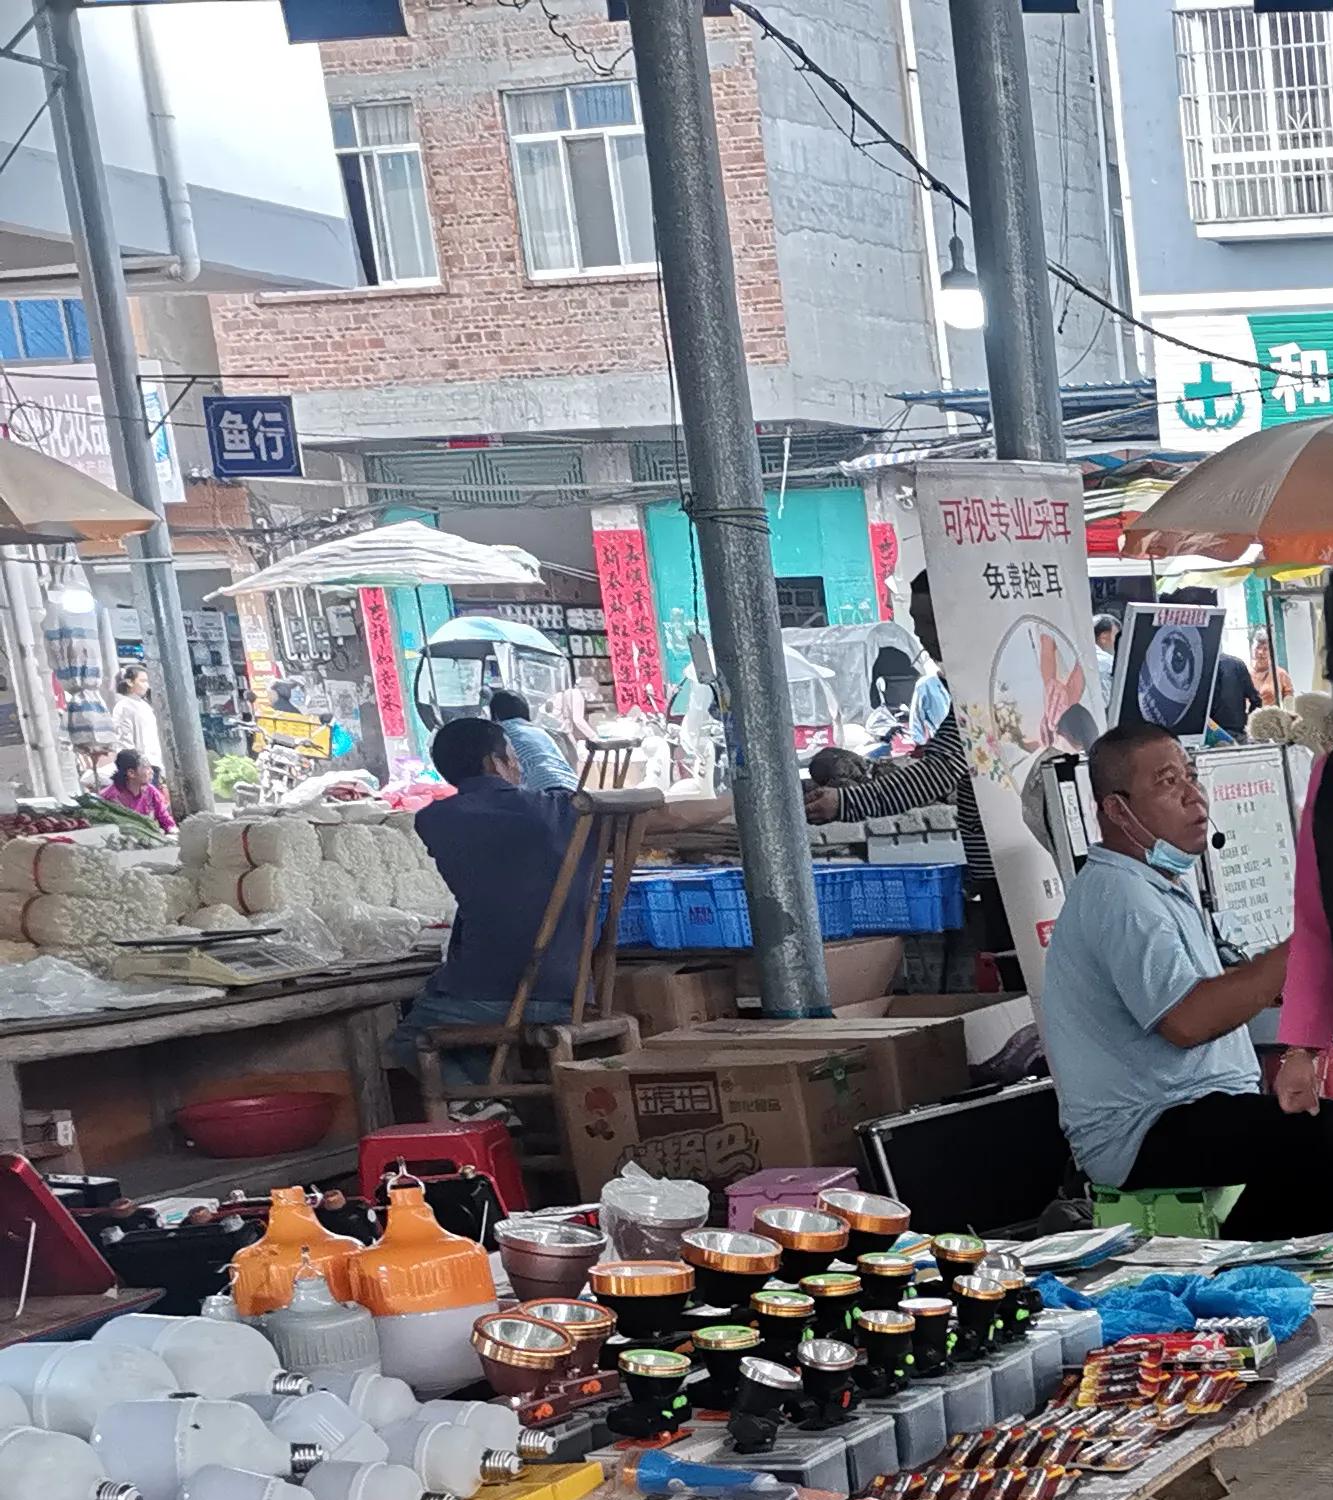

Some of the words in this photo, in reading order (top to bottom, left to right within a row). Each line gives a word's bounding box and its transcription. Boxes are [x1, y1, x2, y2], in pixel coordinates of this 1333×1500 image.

[218, 408, 288, 462] 鱼行
[938, 496, 1071, 546] 可视专业采耳
[982, 562, 1063, 600] 免费检耳
